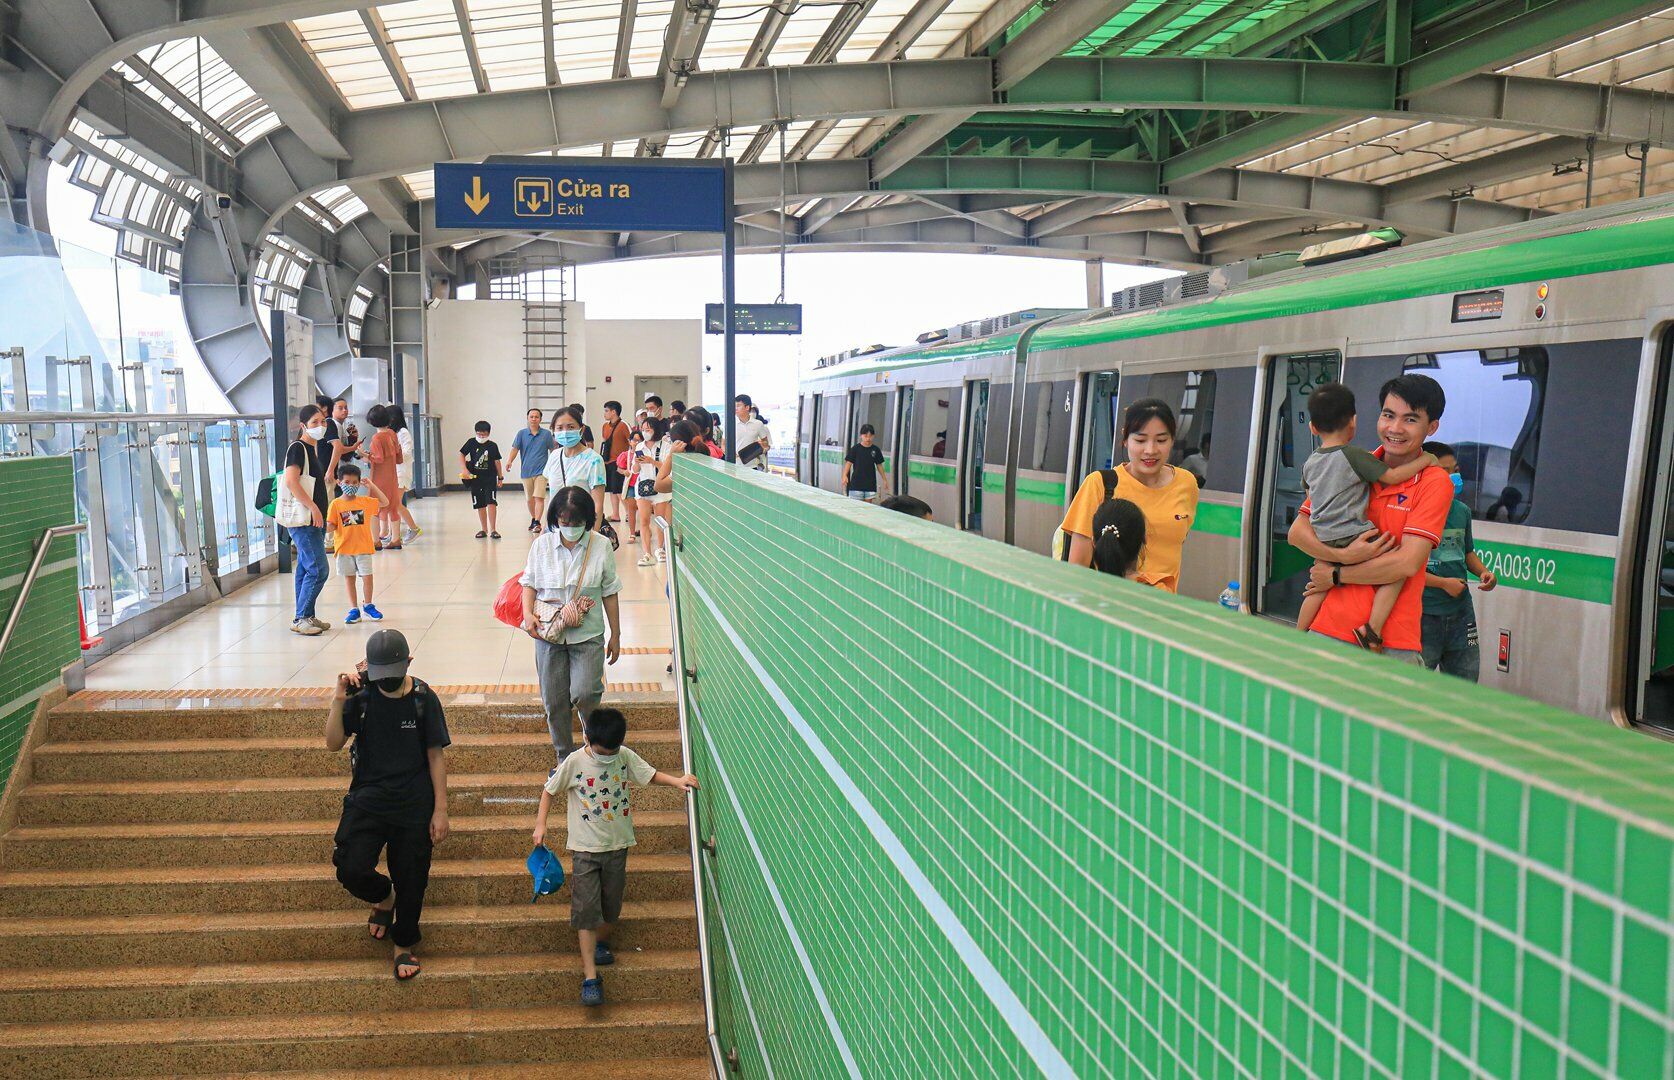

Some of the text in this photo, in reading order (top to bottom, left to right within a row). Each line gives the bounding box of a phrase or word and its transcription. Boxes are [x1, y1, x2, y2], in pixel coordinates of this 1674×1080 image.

[557, 178, 630, 198] Cửa ra
[557, 203, 584, 215] Exit
[1536, 558, 1556, 585] 02
